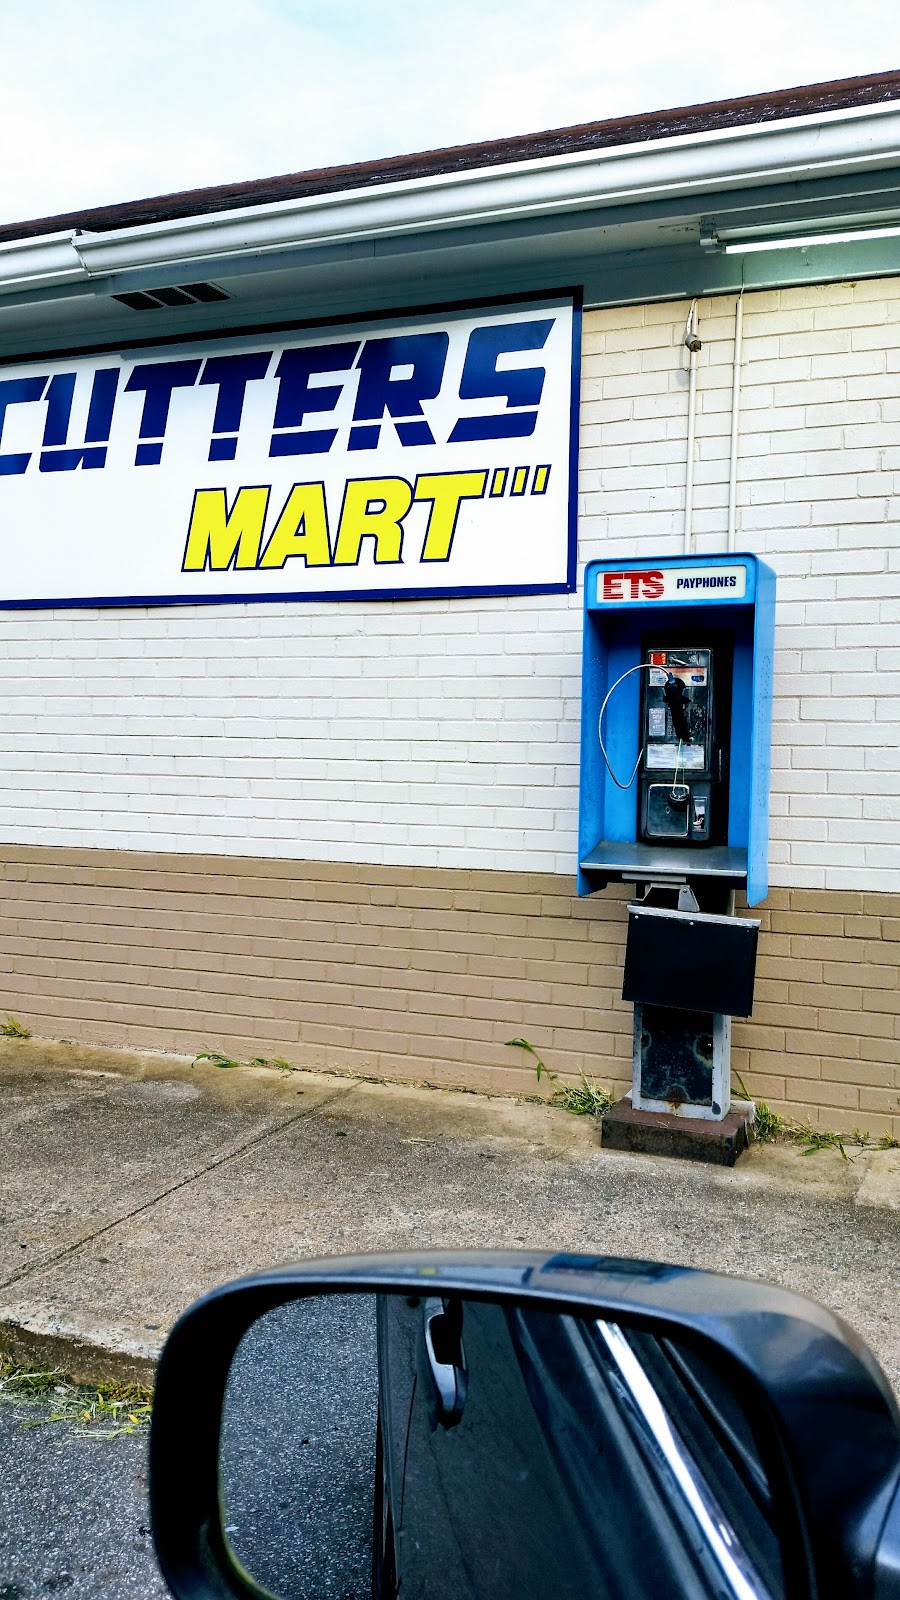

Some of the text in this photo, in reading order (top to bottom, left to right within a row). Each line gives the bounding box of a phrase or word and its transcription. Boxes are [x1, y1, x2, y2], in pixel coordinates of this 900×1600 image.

[181, 468, 490, 573] MART
[603, 570, 737, 600] ETS PAYPHONES
